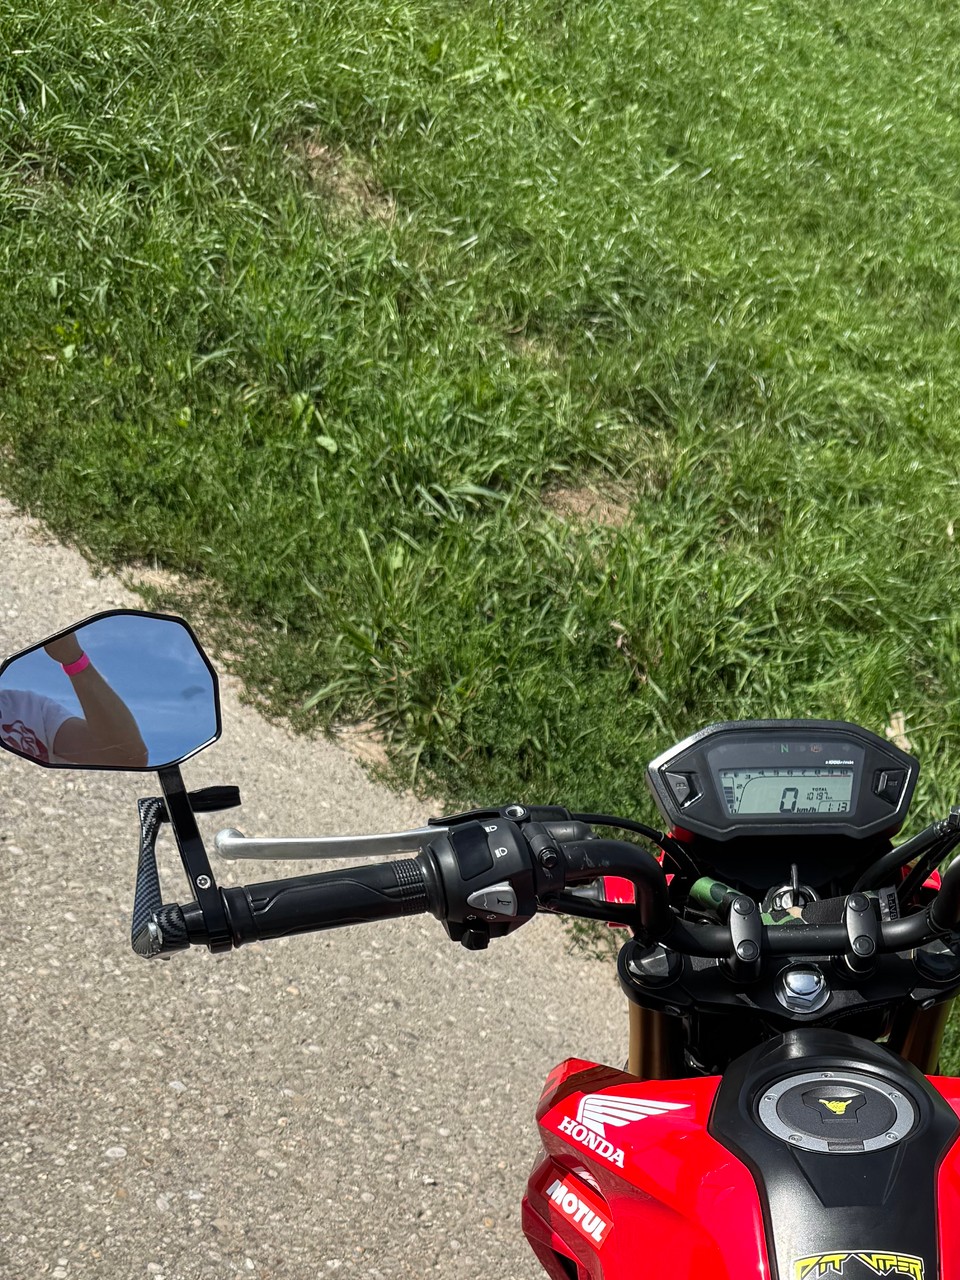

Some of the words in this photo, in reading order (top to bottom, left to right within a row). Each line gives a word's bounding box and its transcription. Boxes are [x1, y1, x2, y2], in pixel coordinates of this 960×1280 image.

[780, 744, 789, 753] N
[780, 787, 799, 813] 0
[827, 802, 848, 812] 1:13
[557, 1115, 625, 1168] HONDA
[545, 1178, 607, 1243] MOTUL
